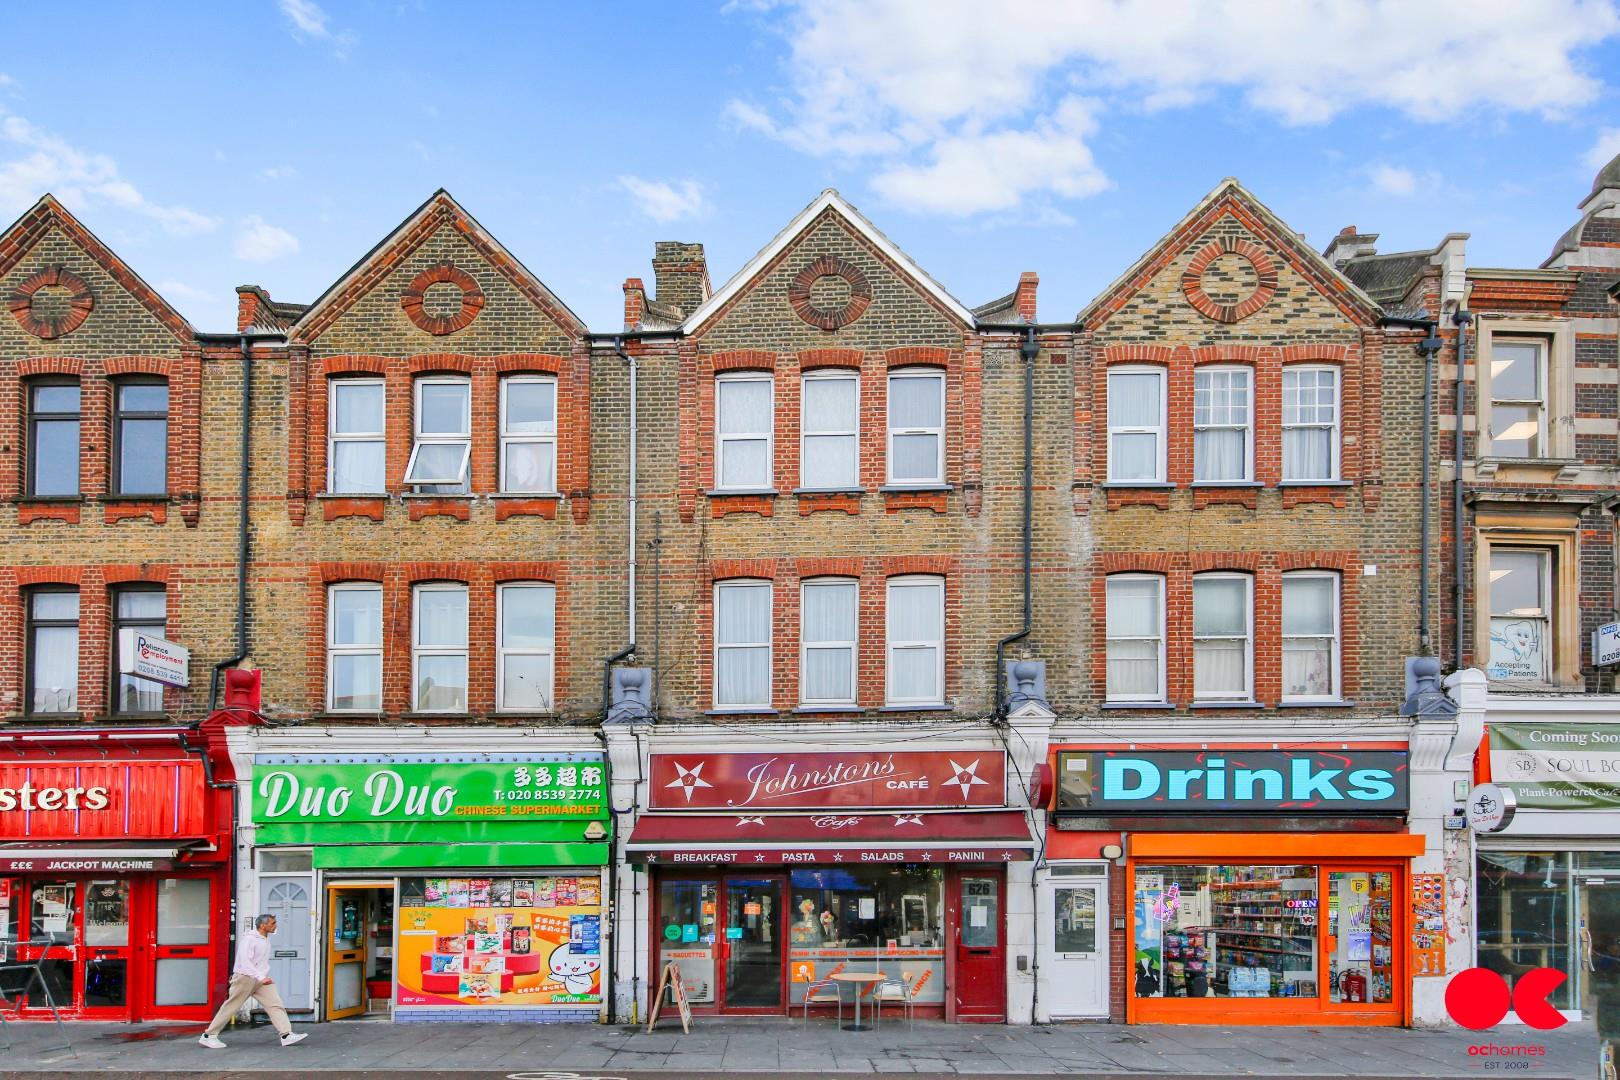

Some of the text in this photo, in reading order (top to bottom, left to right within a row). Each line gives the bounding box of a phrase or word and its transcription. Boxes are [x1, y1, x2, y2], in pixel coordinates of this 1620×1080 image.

[138, 636, 169, 655] Reliance
[1494, 661, 1531, 670] Accepting
[1508, 669, 1538, 677] Patients
[1529, 730, 1620, 746] Coming Soo
[1547, 757, 1596, 773] SOUL
[513, 766, 602, 787] 多多超市
[727, 754, 895, 807] Johnstons
[886, 775, 929, 789] CAFÉ
[1103, 758, 1396, 800] Drinks
[0, 781, 109, 811] sters
[259, 770, 458, 817] Duo Duo
[494, 789, 601, 800] T: 020 8539 2774
[455, 804, 600, 816] CHINESE SUPERMARKET
[673, 851, 985, 862] BREAKFAST PASTA SALADS PANINI
[10, 861, 153, 870] £££ JACKPOT MACHINE
[968, 883, 990, 895] 626
[1286, 900, 1317, 908] OPEN
[90, 919, 129, 927] Welcome
[911, 967, 933, 997] LUNCH
